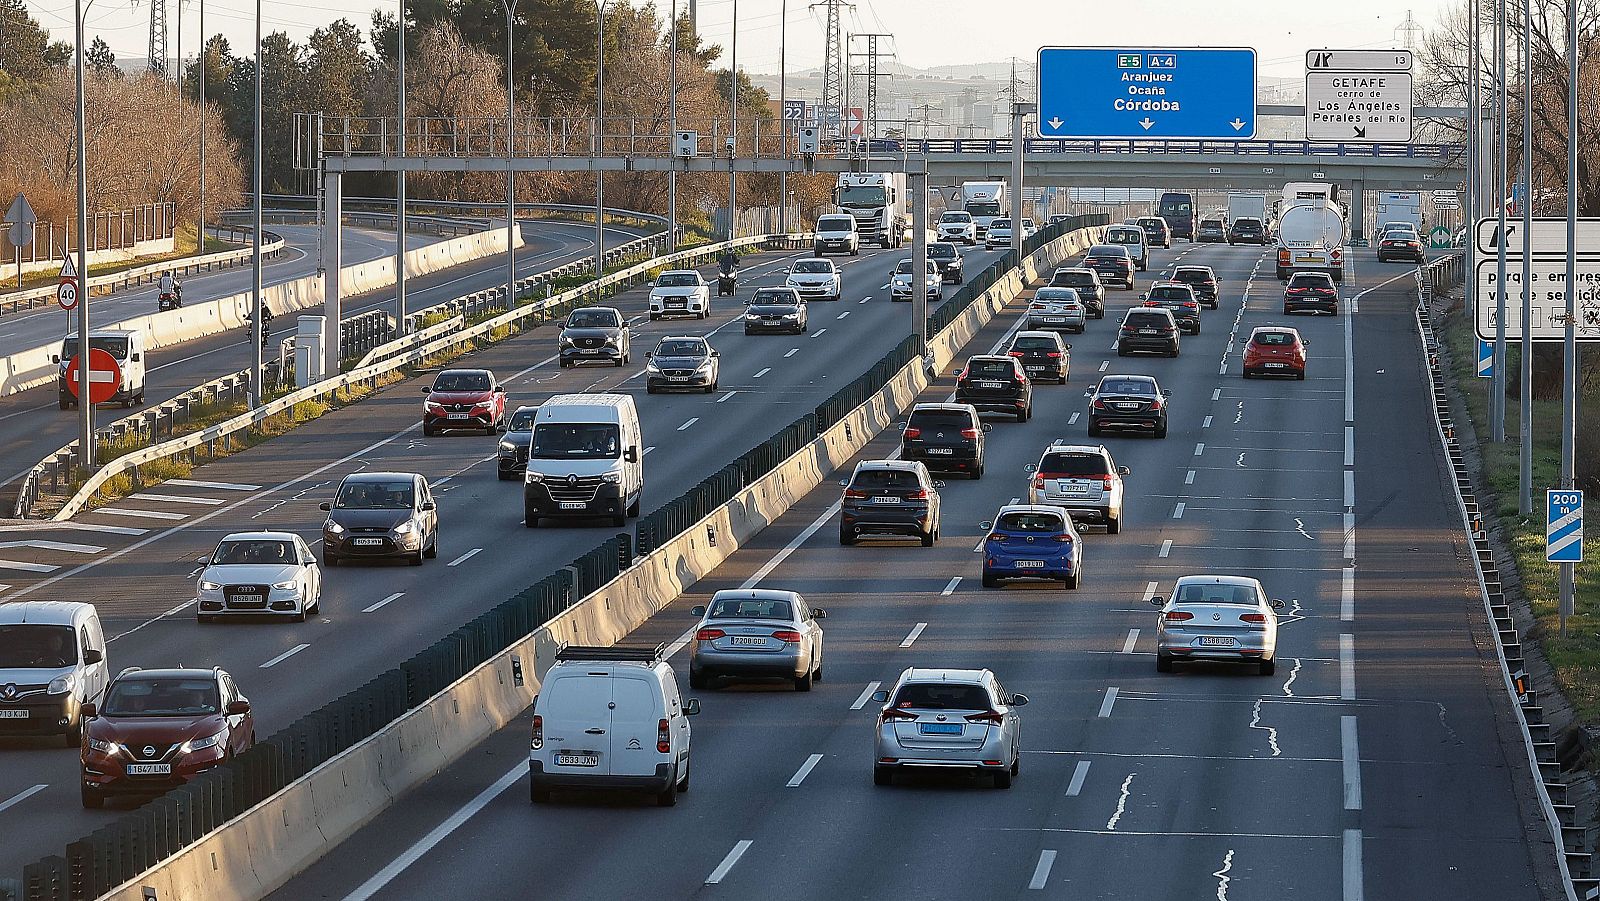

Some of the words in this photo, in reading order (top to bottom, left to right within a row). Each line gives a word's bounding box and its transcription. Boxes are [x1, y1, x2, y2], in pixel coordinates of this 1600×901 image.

[1120, 56, 1140, 66] E-5
[1151, 56, 1174, 66] A-4
[1395, 56, 1406, 64] 13
[1121, 72, 1173, 82] Aranjuez
[1332, 78, 1386, 88] GETAFE
[1128, 85, 1166, 95] Ocaña
[1114, 98, 1180, 110] Córdoba
[1318, 100, 1340, 110] Los
[1348, 98, 1400, 112] Ángeles
[786, 108, 802, 119] 22
[1312, 113, 1362, 122] Perales
[1388, 114, 1406, 122] Río
[1488, 273, 1538, 284] prqe
[1548, 273, 1600, 282] emres
[61, 289, 74, 300] 40
[1552, 494, 1578, 505] 200
[582, 756, 596, 765] JXN
[154, 765, 169, 773] LNK
